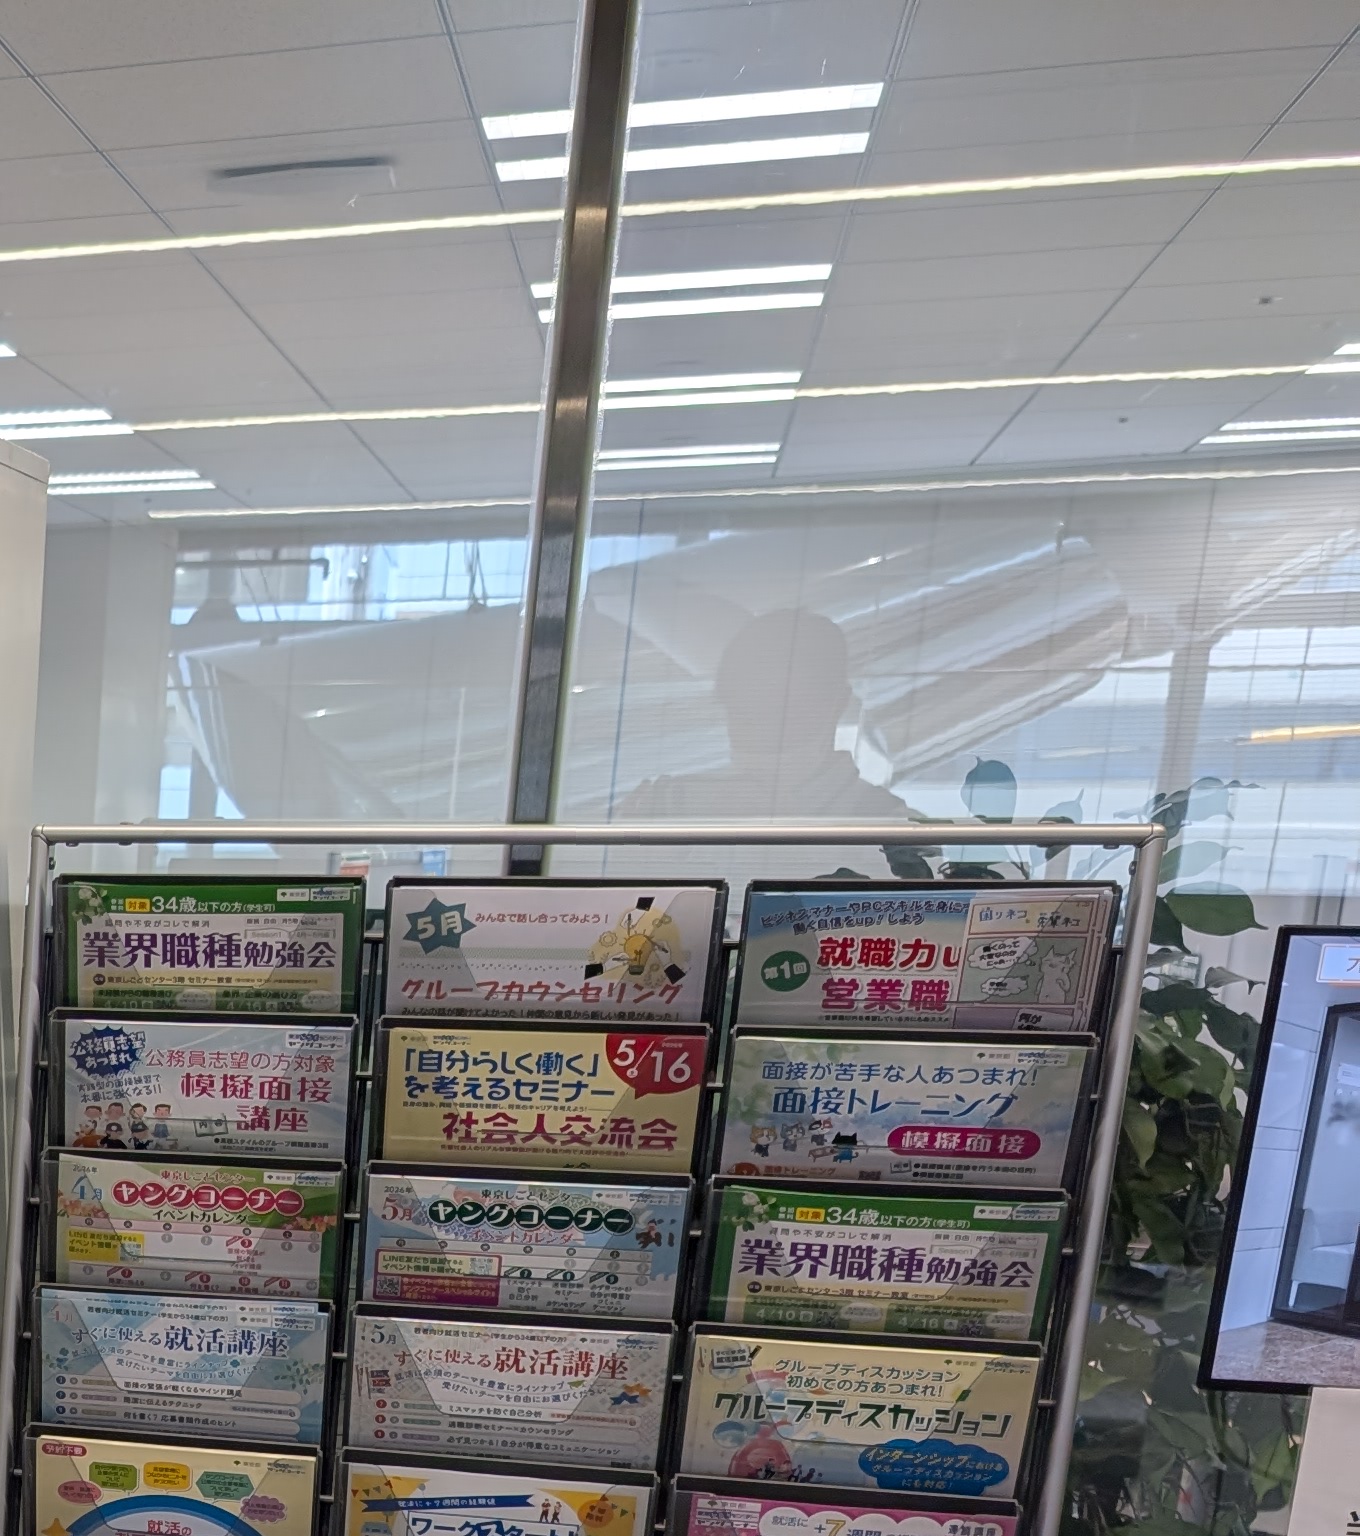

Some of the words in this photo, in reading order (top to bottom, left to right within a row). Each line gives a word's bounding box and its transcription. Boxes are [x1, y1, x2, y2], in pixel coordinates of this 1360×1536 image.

[417, 912, 463, 939] 5月
[475, 911, 609, 925] みんなで話し合ってみよう!
[82, 931, 337, 969] 業界職種勉強会
[401, 978, 683, 1004] グループカウンセリング
[821, 978, 950, 1012] 営業職
[145, 1048, 336, 1073] 公務員志望の方対象
[403, 1048, 600, 1077] 「自分らしく働く」
[612, 1039, 691, 1084] 5/16
[762, 1060, 1038, 1087] 面接が苦手な人あつまれ!
[180, 1072, 333, 1103] 模擬面接
[403, 1076, 615, 1102] を考えるセミナー
[772, 1085, 1019, 1119] 面接トレーニング
[236, 1105, 309, 1132] 講座
[442, 1111, 679, 1152] 社会人交流会
[900, 1130, 1027, 1155] 模擬面接
[114, 1183, 301, 1208] ヤングコーナー
[381, 1194, 413, 1221] 5月
[152, 1209, 263, 1225] イベントカレンダー
[431, 1201, 632, 1231] ヤングコーナー
[825, 1206, 971, 1229] 34歳以下の方(学生可)
[737, 1239, 1035, 1288] 業界職種勉強会
[71, 1324, 289, 1359] すぐに使える就活講座
[370, 1322, 397, 1345] 5月
[393, 1346, 629, 1382] すぐに使える就活講座
[774, 1359, 961, 1383] グループディスカッション
[786, 1375, 944, 1398] 初めての方あつまれ!
[714, 1391, 1012, 1440] グループディスカッション
